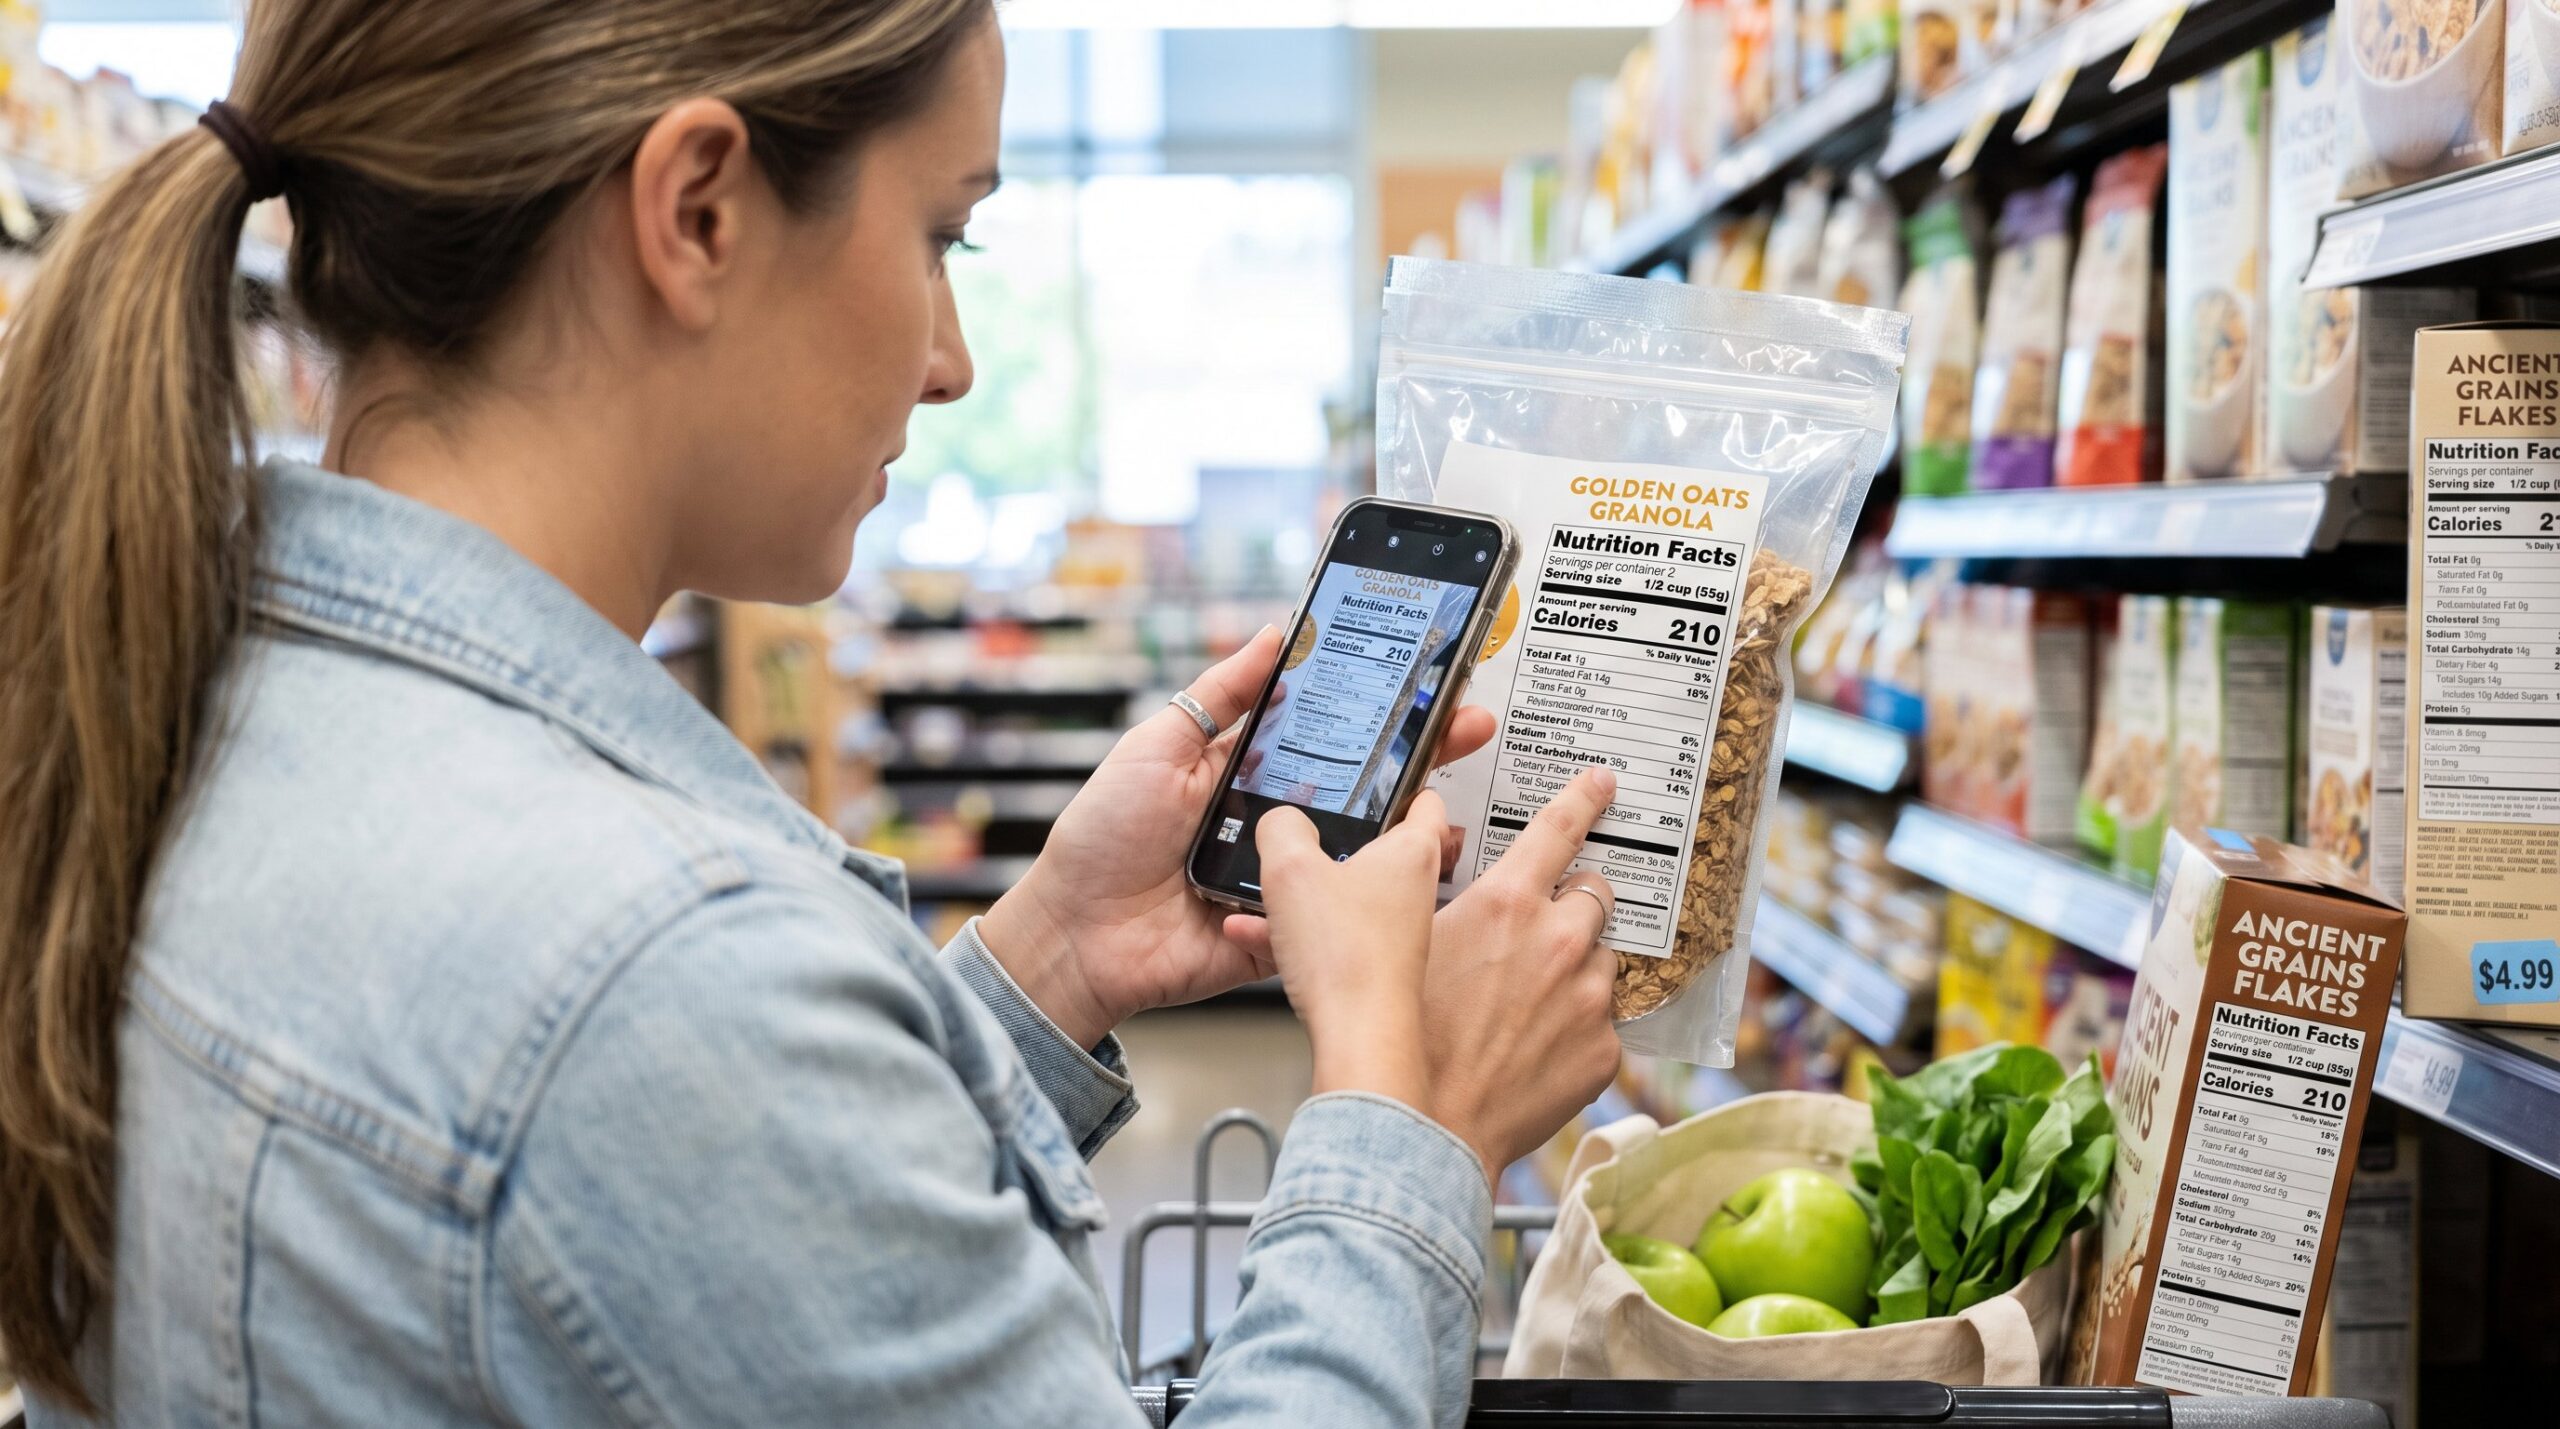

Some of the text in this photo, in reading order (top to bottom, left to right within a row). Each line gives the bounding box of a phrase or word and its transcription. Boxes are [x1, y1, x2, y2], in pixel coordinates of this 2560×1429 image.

[2456, 380, 2558, 400] GRAINS
[2458, 406, 2557, 426] FLAKES
[2429, 443, 2560, 460] Nutrition Fac
[2428, 466, 2534, 478] Servings per container
[2428, 479, 2550, 490] Serving size 1/2 cup
[1571, 476, 1750, 509] GOLDEN OATS
[1590, 501, 1713, 531] GRANOLA
[2428, 505, 2510, 514] Amount per serving
[2428, 516, 2502, 531] Calories
[1553, 530, 1737, 567] Nutrition Facts
[2535, 542, 2553, 551] Daily
[1548, 556, 1676, 578] Servings per container 2
[2428, 555, 2467, 564] Total Fat
[1355, 568, 1405, 586] GOLDEN
[2437, 570, 2503, 581] Saturated Fat 0g
[1362, 582, 1421, 601] GRANOLA
[1545, 568, 1729, 603] Serving size 1/2 cup (55g)
[2438, 585, 2487, 596] Trans Fat 0g
[1341, 595, 1392, 614] Nutrition
[1395, 605, 1428, 620] Facts
[1538, 595, 1637, 616] Amount per serving
[2504, 601, 2528, 611] Fat 0g
[1534, 608, 1720, 646] Calories 210
[2426, 616, 2479, 624] Cholesterol
[2426, 630, 2460, 639] Sodium
[1324, 637, 1365, 653] Calories
[1386, 647, 1411, 662] 210
[1526, 648, 1571, 662] Total Fat
[1646, 649, 1682, 662] % Daily
[2426, 645, 2530, 656] Total Carbohydrate 14g
[2436, 660, 2498, 671] Dietary Fiber 4g
[1532, 664, 1709, 700] Saturated Fat 14g 18%
[2437, 675, 2502, 685] Total Sugars 14g
[1531, 680, 1586, 698] Trans Fat 0g
[2442, 690, 2474, 699] Includes
[2494, 691, 2519, 700] Added
[2521, 691, 2548, 702] Sugars
[1612, 709, 1628, 720] 10g
[2425, 705, 2471, 715] Protein 5g
[1511, 710, 1699, 747] Cholesterol 6%
[1508, 726, 1696, 764] Sodium 9%
[2425, 743, 2456, 752] Calcium
[1505, 740, 1693, 780] Total Carbohydrate 38g 14%
[1510, 774, 1533, 785] Total
[1514, 758, 1690, 796] Dietary Fiber 14%
[1492, 804, 1529, 817] Protein
[1608, 807, 1683, 828] Sugars 20%
[1660, 859, 1675, 870] 0%
[1658, 876, 1672, 886] 0%
[1654, 892, 1669, 903] 0%
[2231, 910, 2386, 962] ANCIENT
[2238, 941, 2367, 989] GRAINS
[2479, 958, 2553, 994] $4.99
[2233, 969, 2358, 1018] FLAKES
[2216, 1006, 2300, 1038] Nutrition
[2306, 1025, 2359, 1050] Facts
[2211, 1039, 2324, 1072] Serving size 1/2 cup
[2206, 1062, 2244, 1075] Amount per
[2204, 1072, 2346, 1112] Calories 210
[2198, 1106, 2339, 1142] Total Fat 18%
[2224, 1144, 2236, 1154] Fat
[2244, 1131, 2335, 1157] Fat 19%
[2180, 1183, 2229, 1200] Cholesterol
[2178, 1198, 2210, 1211] Sodium
[2175, 1212, 2196, 1224] Total
[2177, 1243, 2194, 1253] Total
[2210, 1235, 2230, 1246] Fiber
[2232, 1239, 2242, 1250] 4g
[2162, 1269, 2206, 1287] Protein 5g
[2229, 1270, 2253, 1282] Added
[2254, 1276, 2281, 1289] Sugars
[2285, 1282, 2305, 1293] 20%
[2157, 1291, 2195, 1306] Vitamin D
[2153, 1306, 2184, 1320] Calcium
[2150, 1321, 2165, 1330] Iron
[2147, 1336, 2187, 1352] Potassium
